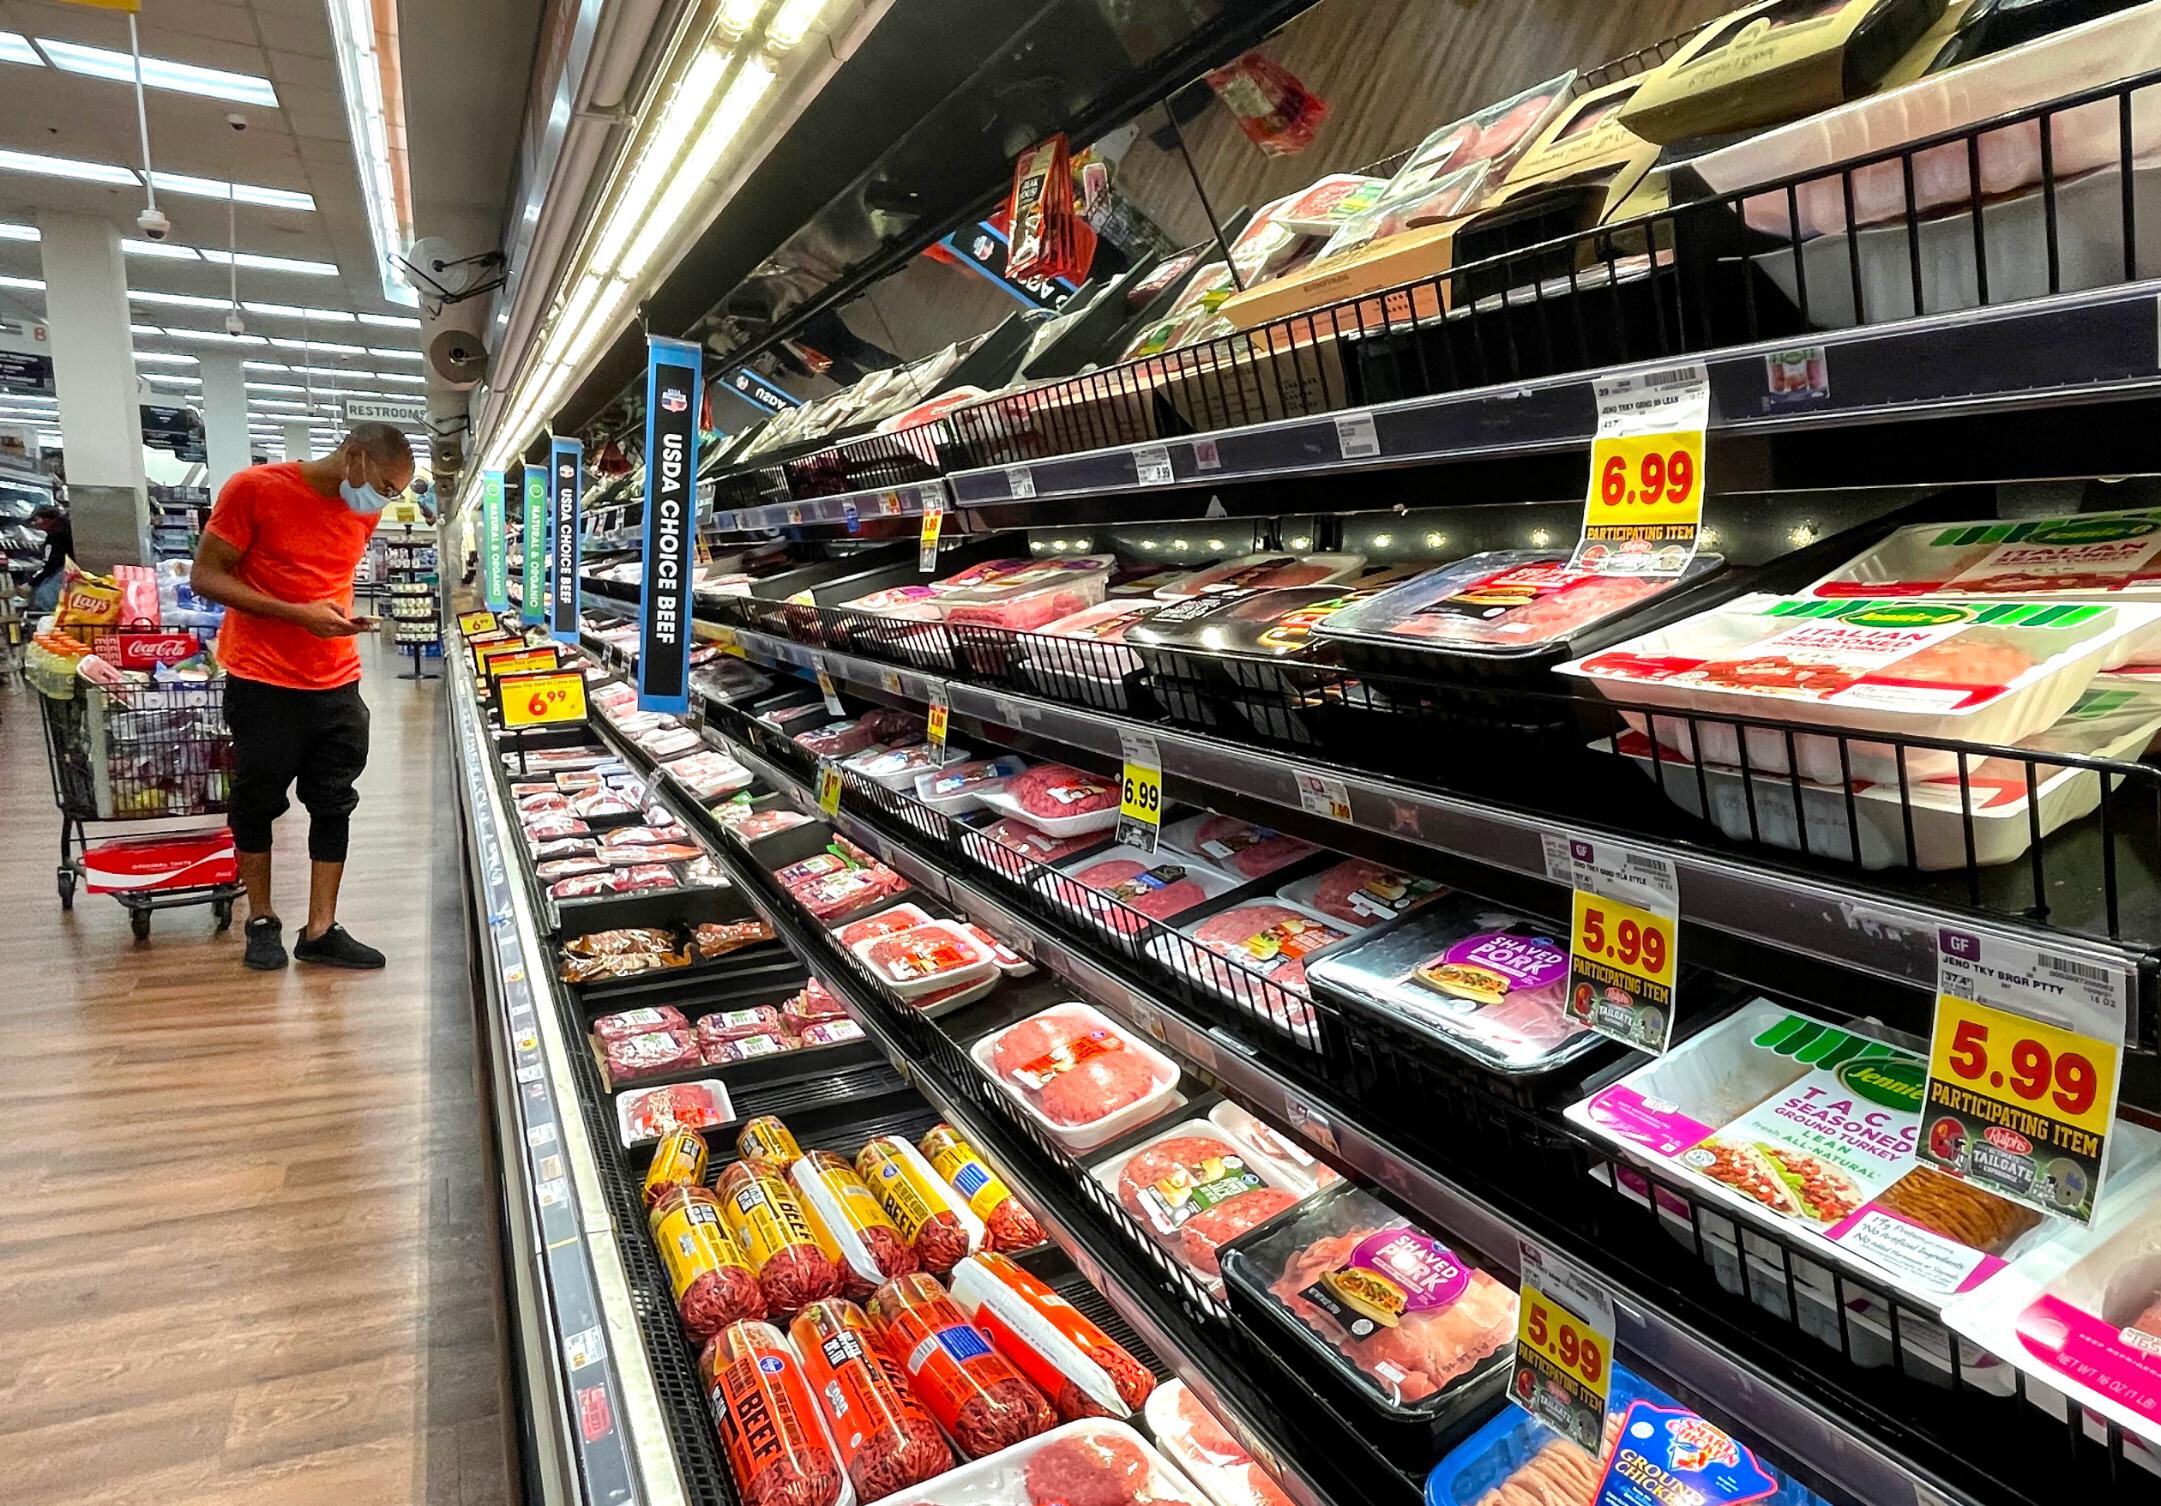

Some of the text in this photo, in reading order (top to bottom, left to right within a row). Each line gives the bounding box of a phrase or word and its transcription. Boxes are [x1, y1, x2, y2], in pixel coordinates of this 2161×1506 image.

[349, 404, 427, 419] RESTROOMS
[1601, 450, 1694, 507] 6.99
[560, 489, 573, 604] USDA CHOICE BEEF
[656, 433, 683, 645] USDA CHOICE BEEF
[1587, 526, 1694, 541] PARTICIPATING ITEM
[529, 505, 541, 608] NATURAL & ORGANIC
[73, 593, 109, 613] Lay's
[1782, 636, 1913, 648] SEASONED
[1797, 628, 1932, 641] ITALIAN
[1124, 777, 1159, 812] 6.99
[1471, 943, 1553, 976] PORK
[1490, 936, 1563, 964] SHAVED
[1582, 908, 1666, 974] 5.99
[1950, 936, 1969, 952] GF
[1573, 956, 1669, 1005] PARTICIPATING ITEM
[1942, 957, 1970, 970] JENO
[1973, 964, 1995, 977] TKY
[1997, 971, 2030, 988] BRGR
[2032, 980, 2065, 996] PTTY
[1847, 1066, 1926, 1100] Jennie
[1948, 1019, 2097, 1116] 5.99
[1752, 1120, 1781, 1139] fresh
[1774, 1107, 1902, 1164] GROUND TURKEY
[1784, 1098, 1914, 1155] SEASONED
[1802, 1128, 1852, 1155] LEAN
[1931, 1082, 2099, 1159] PARTICIPATING ITEM
[1988, 1127, 2027, 1152] Ralphs
[1973, 1150, 2034, 1182] TAILGATE
[884, 1194, 917, 1242] BEEF
[1853, 1232, 1871, 1244] No
[1862, 1223, 1880, 1235] No
[1376, 1243, 1449, 1294] PORK
[1394, 1235, 1459, 1279] SHAVED
[1528, 1302, 1602, 1383] 5.99
[1518, 1343, 1579, 1396] PARTICIPATING
[1580, 1386, 1603, 1413] ITEM
[2056, 1352, 2080, 1369] NET
[2077, 1362, 2099, 1378] WT
[2097, 1374, 2111, 1386] 16
[2109, 1380, 2128, 1394] OZ
[736, 1389, 783, 1463] BEEF
[1615, 1461, 1697, 1506] CHICKE
